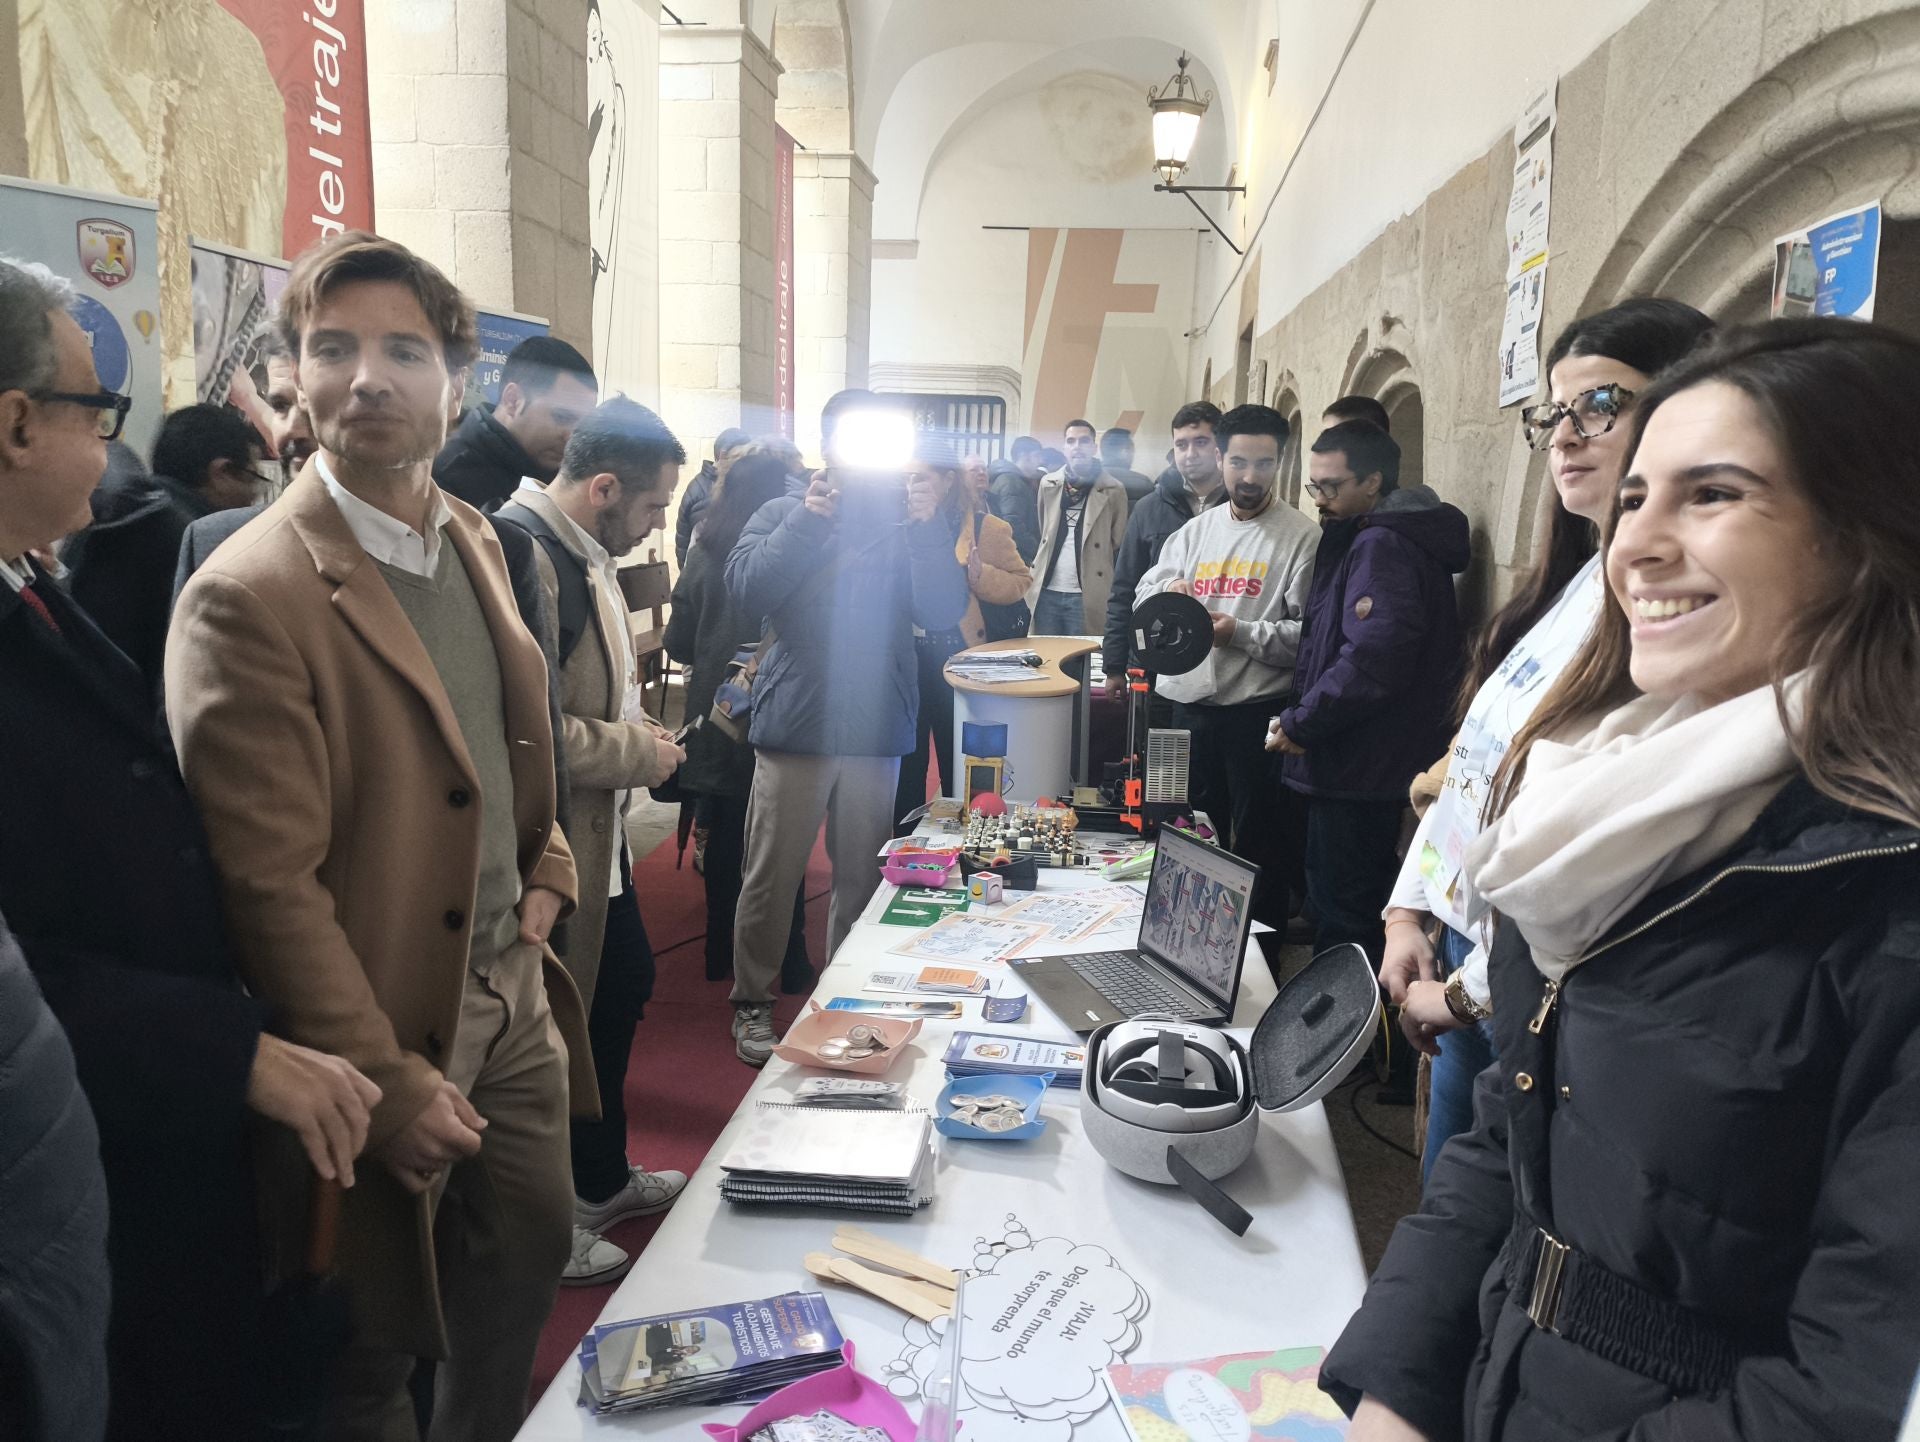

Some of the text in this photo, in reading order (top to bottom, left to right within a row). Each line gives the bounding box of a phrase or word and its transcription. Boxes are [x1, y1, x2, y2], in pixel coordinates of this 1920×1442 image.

[309, 147, 345, 246] del
[779, 337, 787, 386] del
[1194, 573, 1263, 596] sixties
[1195, 555, 1269, 579] golden
[774, 1296, 792, 1335] SUPERIOR
[991, 1270, 1053, 1333] te sorprenda
[1006, 1265, 1089, 1359] Deja que el mundo
[1059, 1300, 1096, 1341] ¡VIAJA!
[732, 1311, 753, 1356] TURÍSTICOS
[743, 1303, 770, 1358] ALOJAMIENTOS
[760, 1307, 783, 1351] GESTIÓN DE
